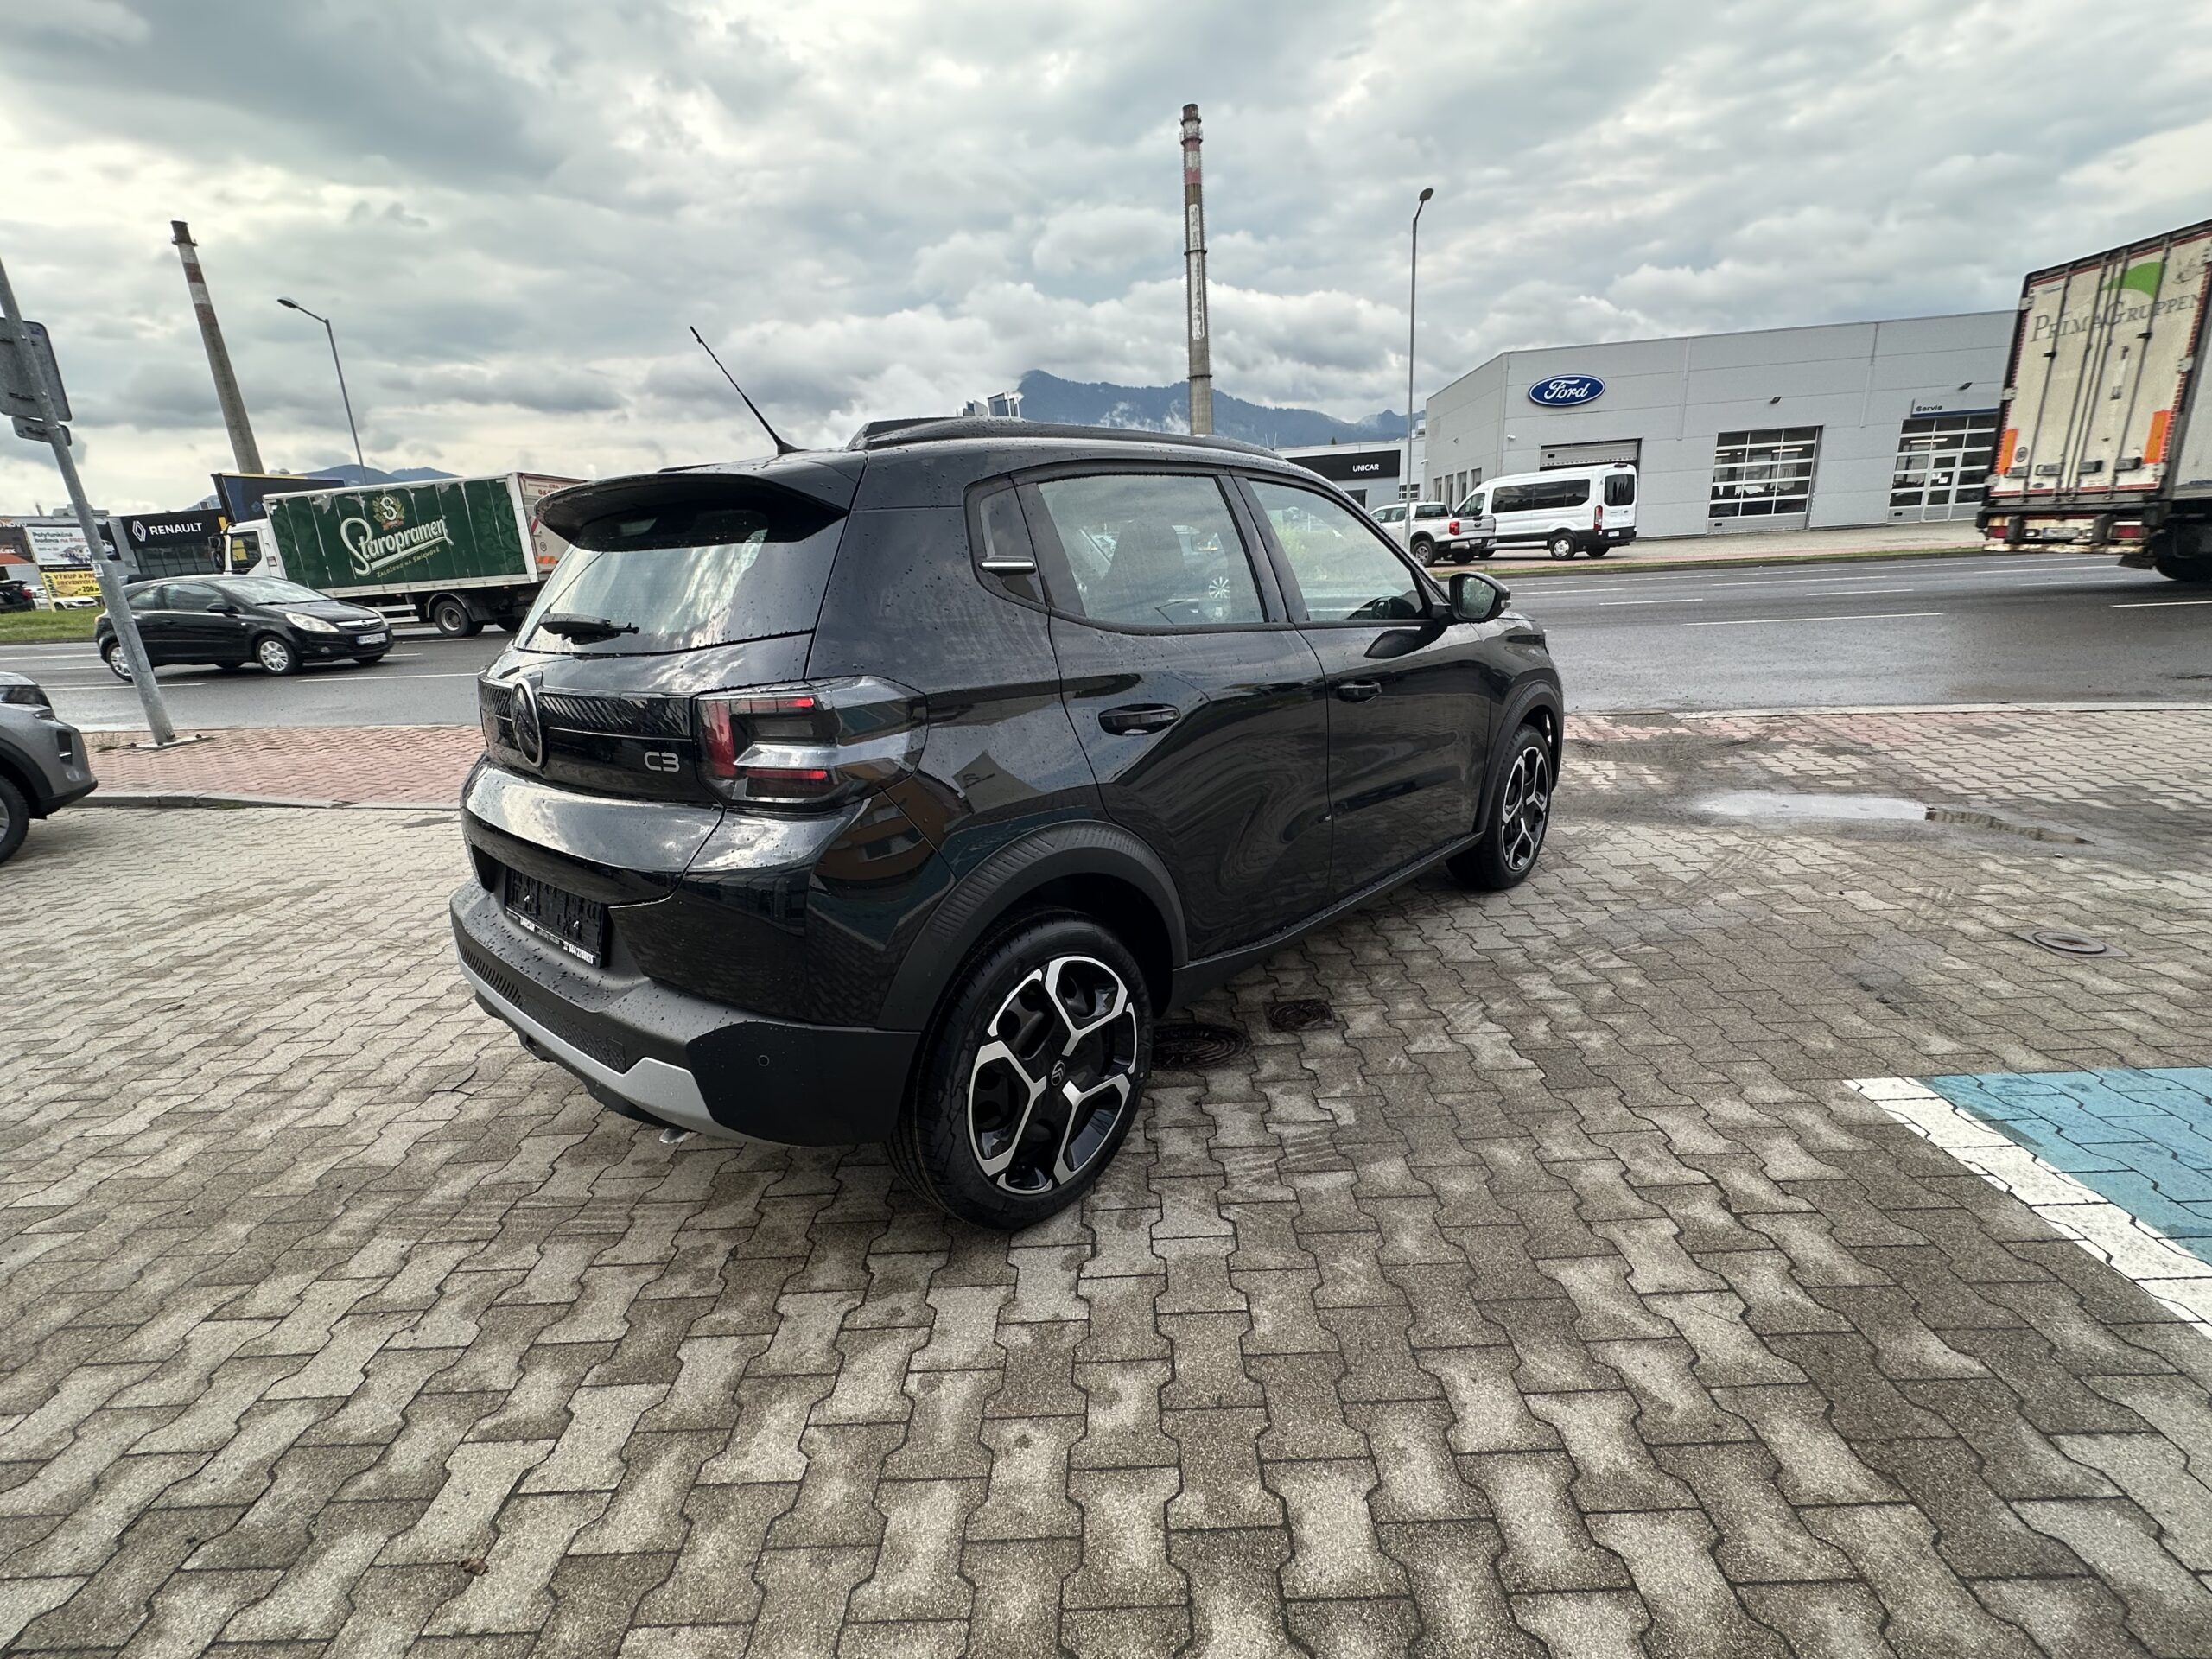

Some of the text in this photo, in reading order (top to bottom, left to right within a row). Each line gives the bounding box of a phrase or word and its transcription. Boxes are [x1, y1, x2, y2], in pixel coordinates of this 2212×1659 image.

[1543, 378, 1591, 400] Ford
[1352, 463, 1380, 472] UNICAR
[149, 522, 203, 536] RENAULT
[340, 517, 454, 576] Staropramen
[644, 751, 680, 772] C3
